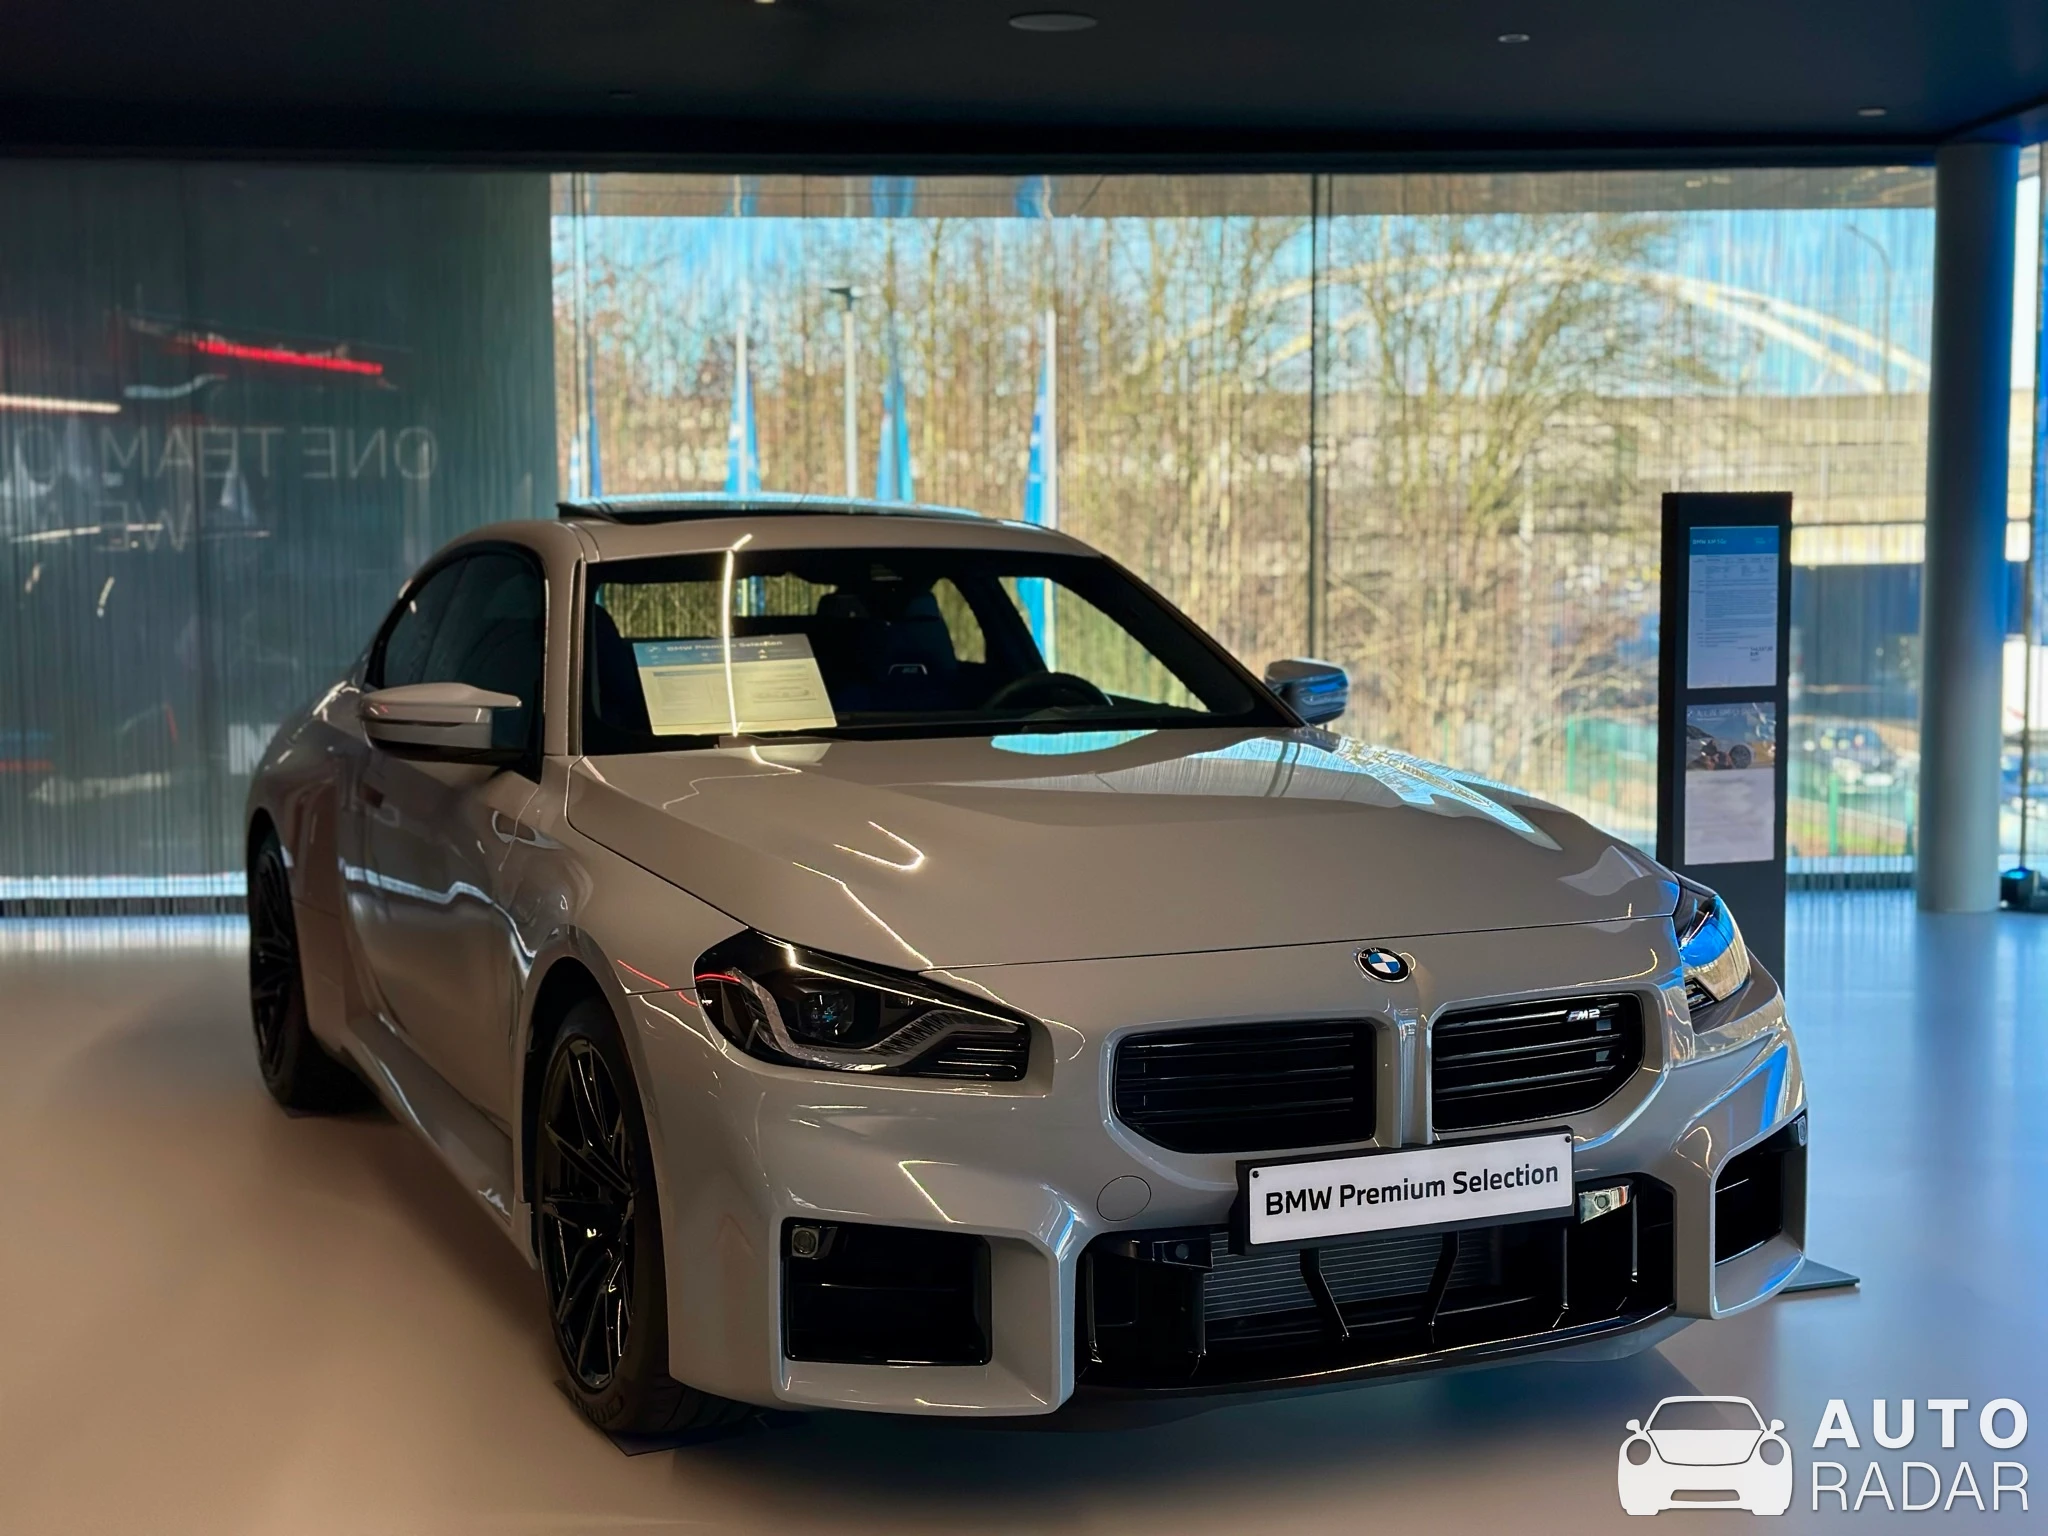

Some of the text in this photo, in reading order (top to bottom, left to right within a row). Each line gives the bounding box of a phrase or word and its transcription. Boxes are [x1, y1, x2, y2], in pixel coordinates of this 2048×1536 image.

[667, 640, 783, 653] BMW Premim Selection
[1265, 1163, 1559, 1216] BMW Premium Selection
